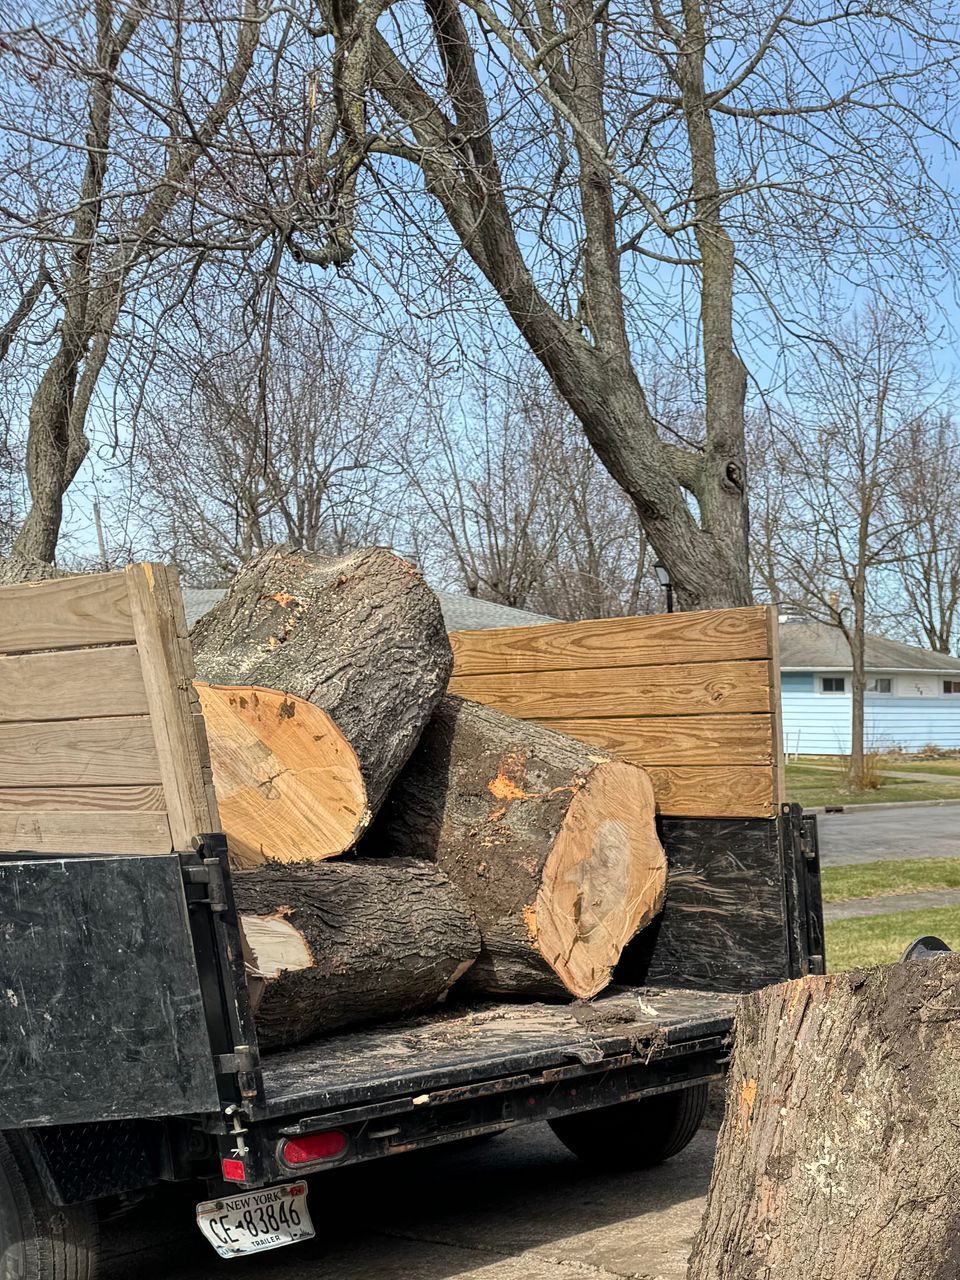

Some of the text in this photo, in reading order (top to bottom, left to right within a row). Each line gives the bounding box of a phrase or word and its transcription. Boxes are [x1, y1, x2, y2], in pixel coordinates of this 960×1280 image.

[225, 1197, 252, 1213] NEW
[252, 1190, 282, 1206] YORK
[251, 1234, 282, 1248] TRAILER
